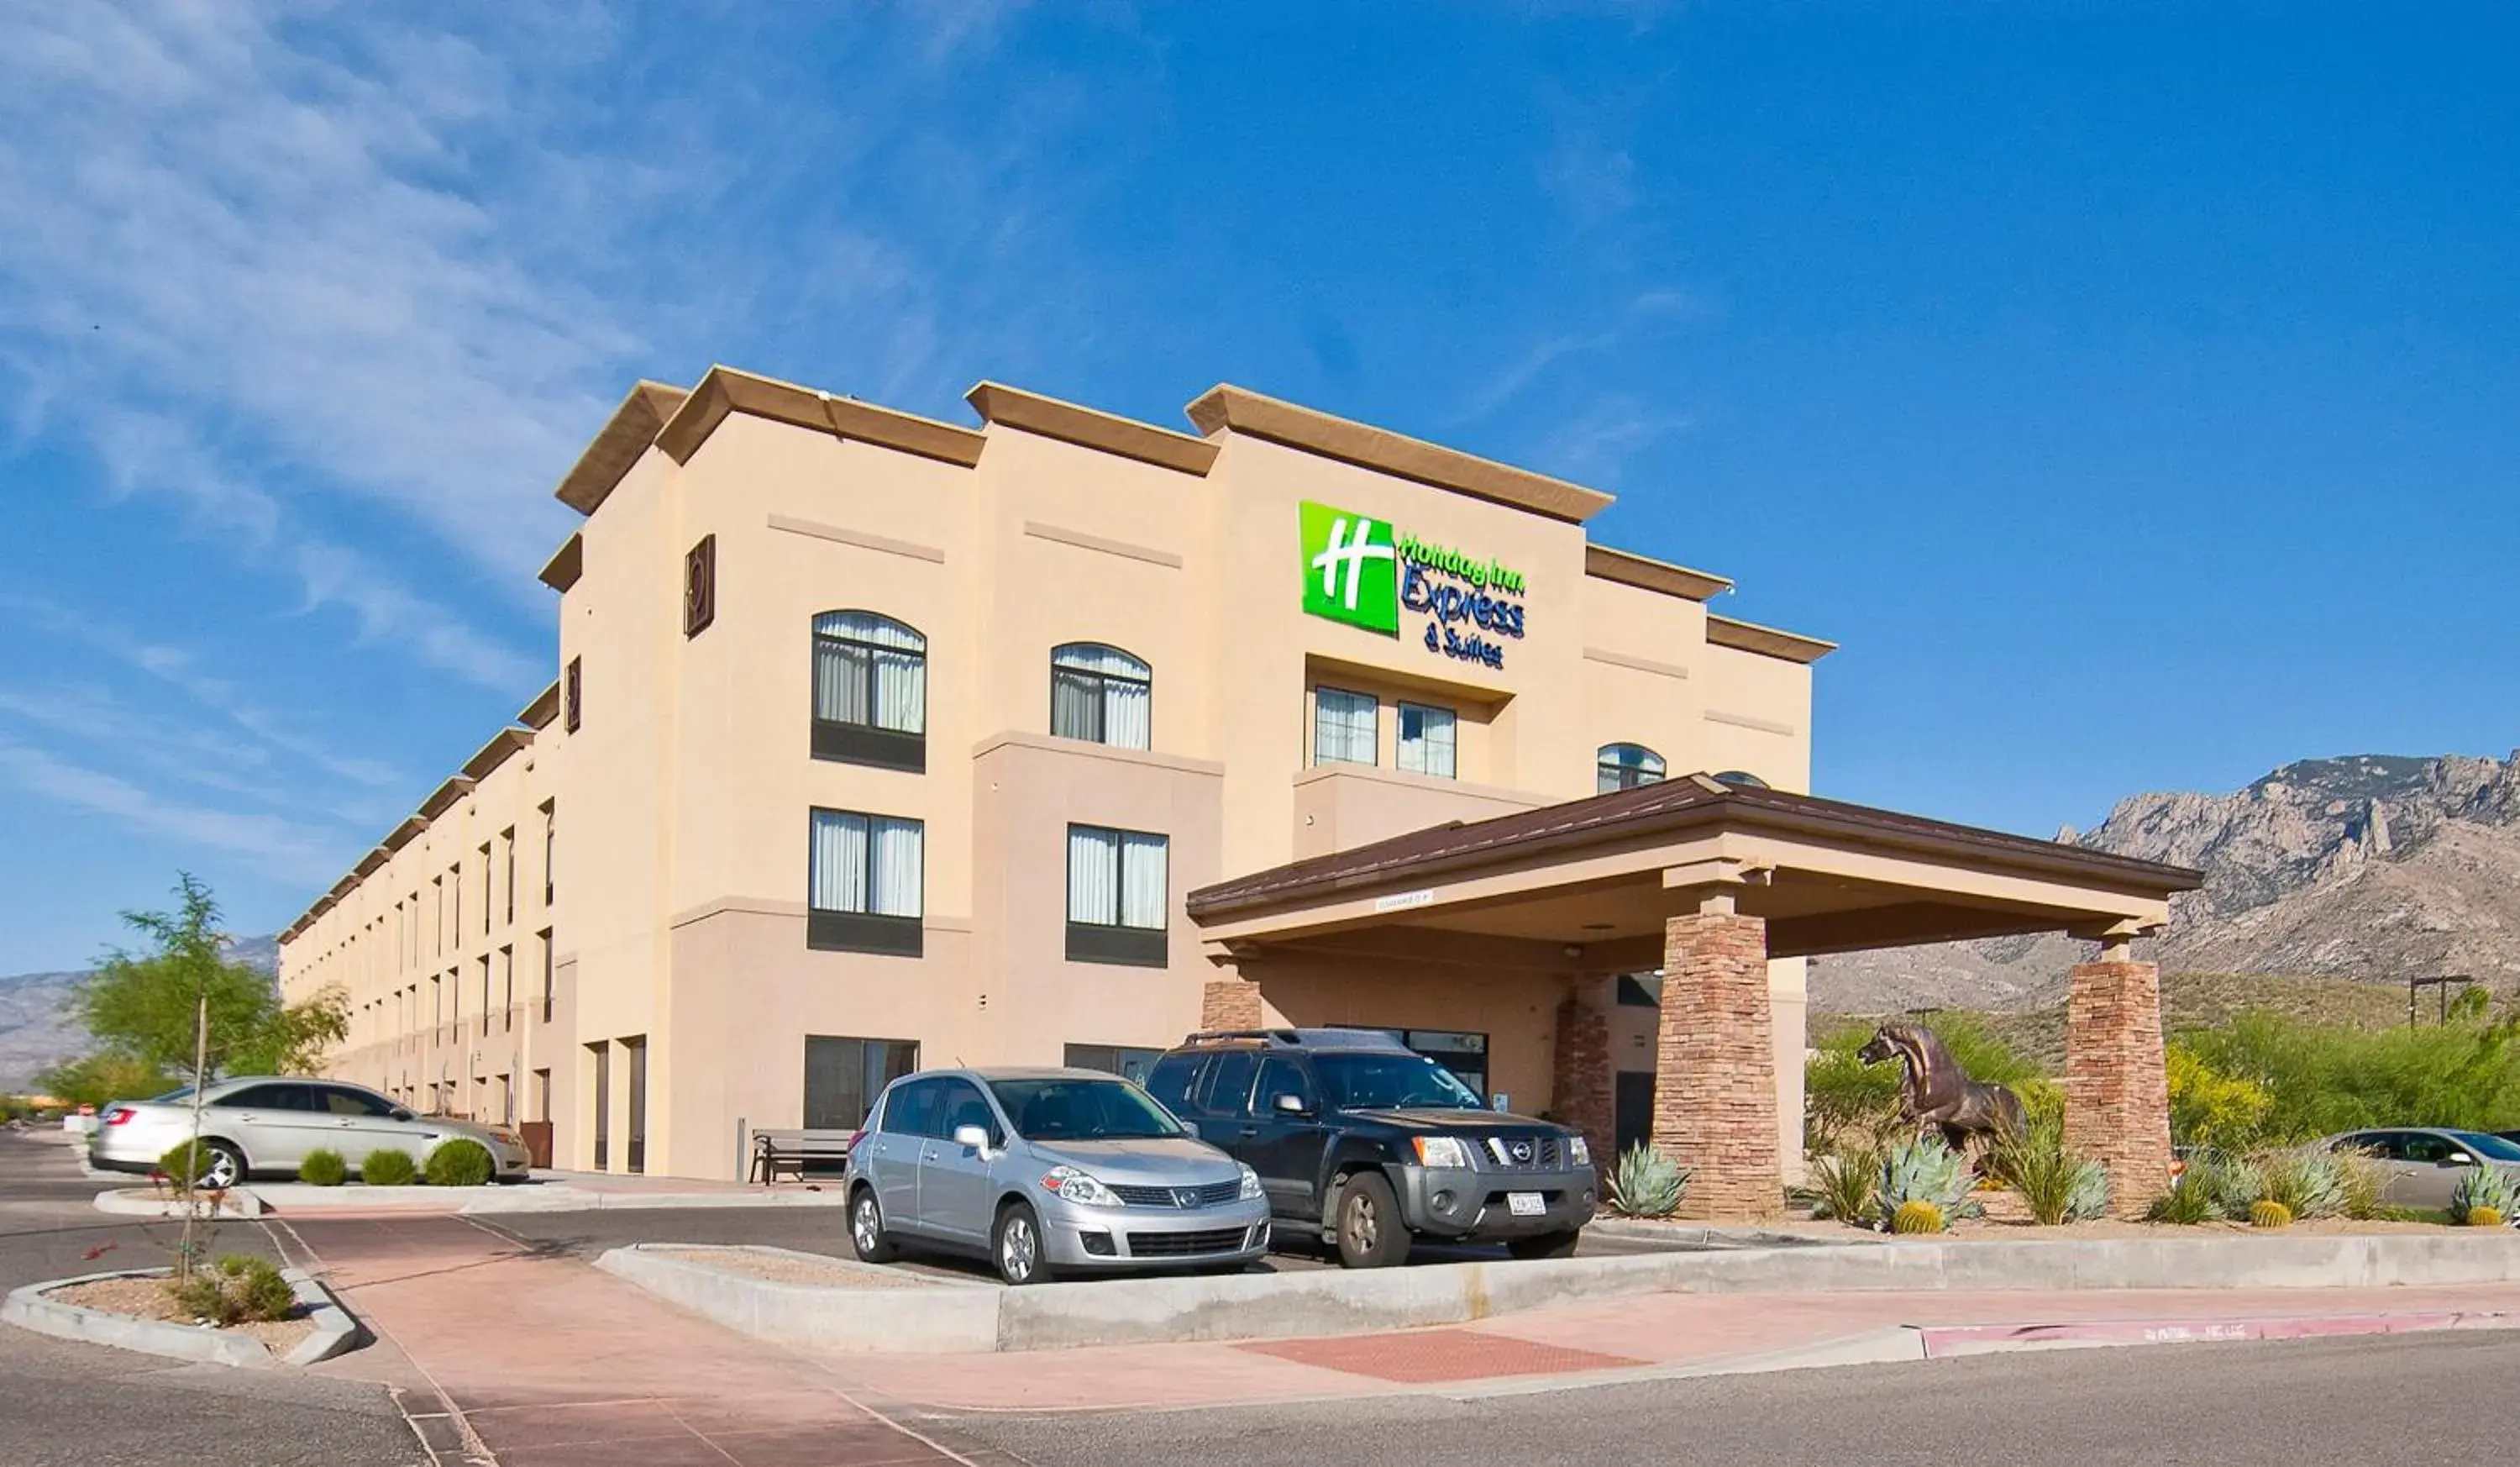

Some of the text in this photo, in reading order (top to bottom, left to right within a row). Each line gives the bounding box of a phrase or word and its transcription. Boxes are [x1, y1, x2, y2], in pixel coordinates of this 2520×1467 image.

[1399, 534, 1525, 593] Holiday Inn
[1402, 564, 1524, 639] Express
[1425, 622, 1504, 670] & Suites
